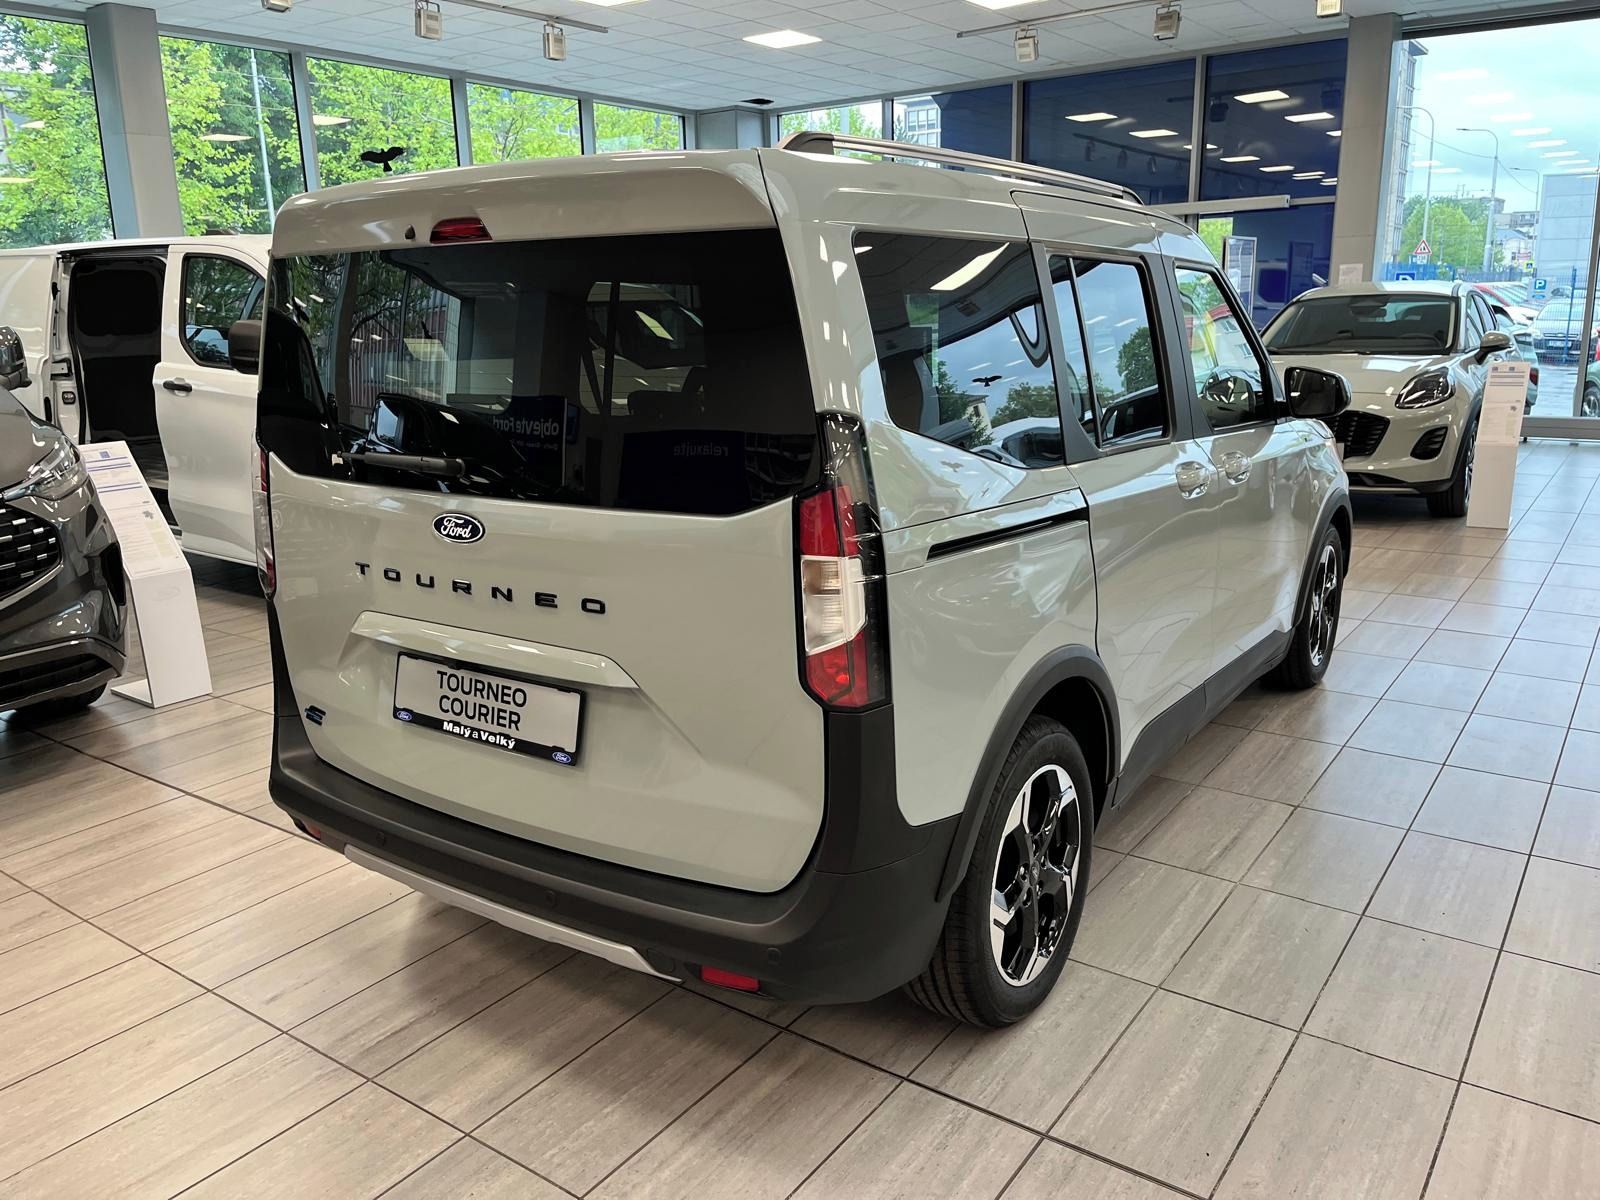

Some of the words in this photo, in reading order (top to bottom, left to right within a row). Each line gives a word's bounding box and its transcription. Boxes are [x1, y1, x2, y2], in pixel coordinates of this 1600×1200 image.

[441, 516, 472, 538] Ford
[354, 561, 606, 615] TOURNEO
[437, 670, 527, 708] TOURNEO
[438, 694, 521, 731] COURIER
[443, 721, 471, 738] Malý
[472, 730, 479, 739] a
[480, 730, 516, 749] Velký
